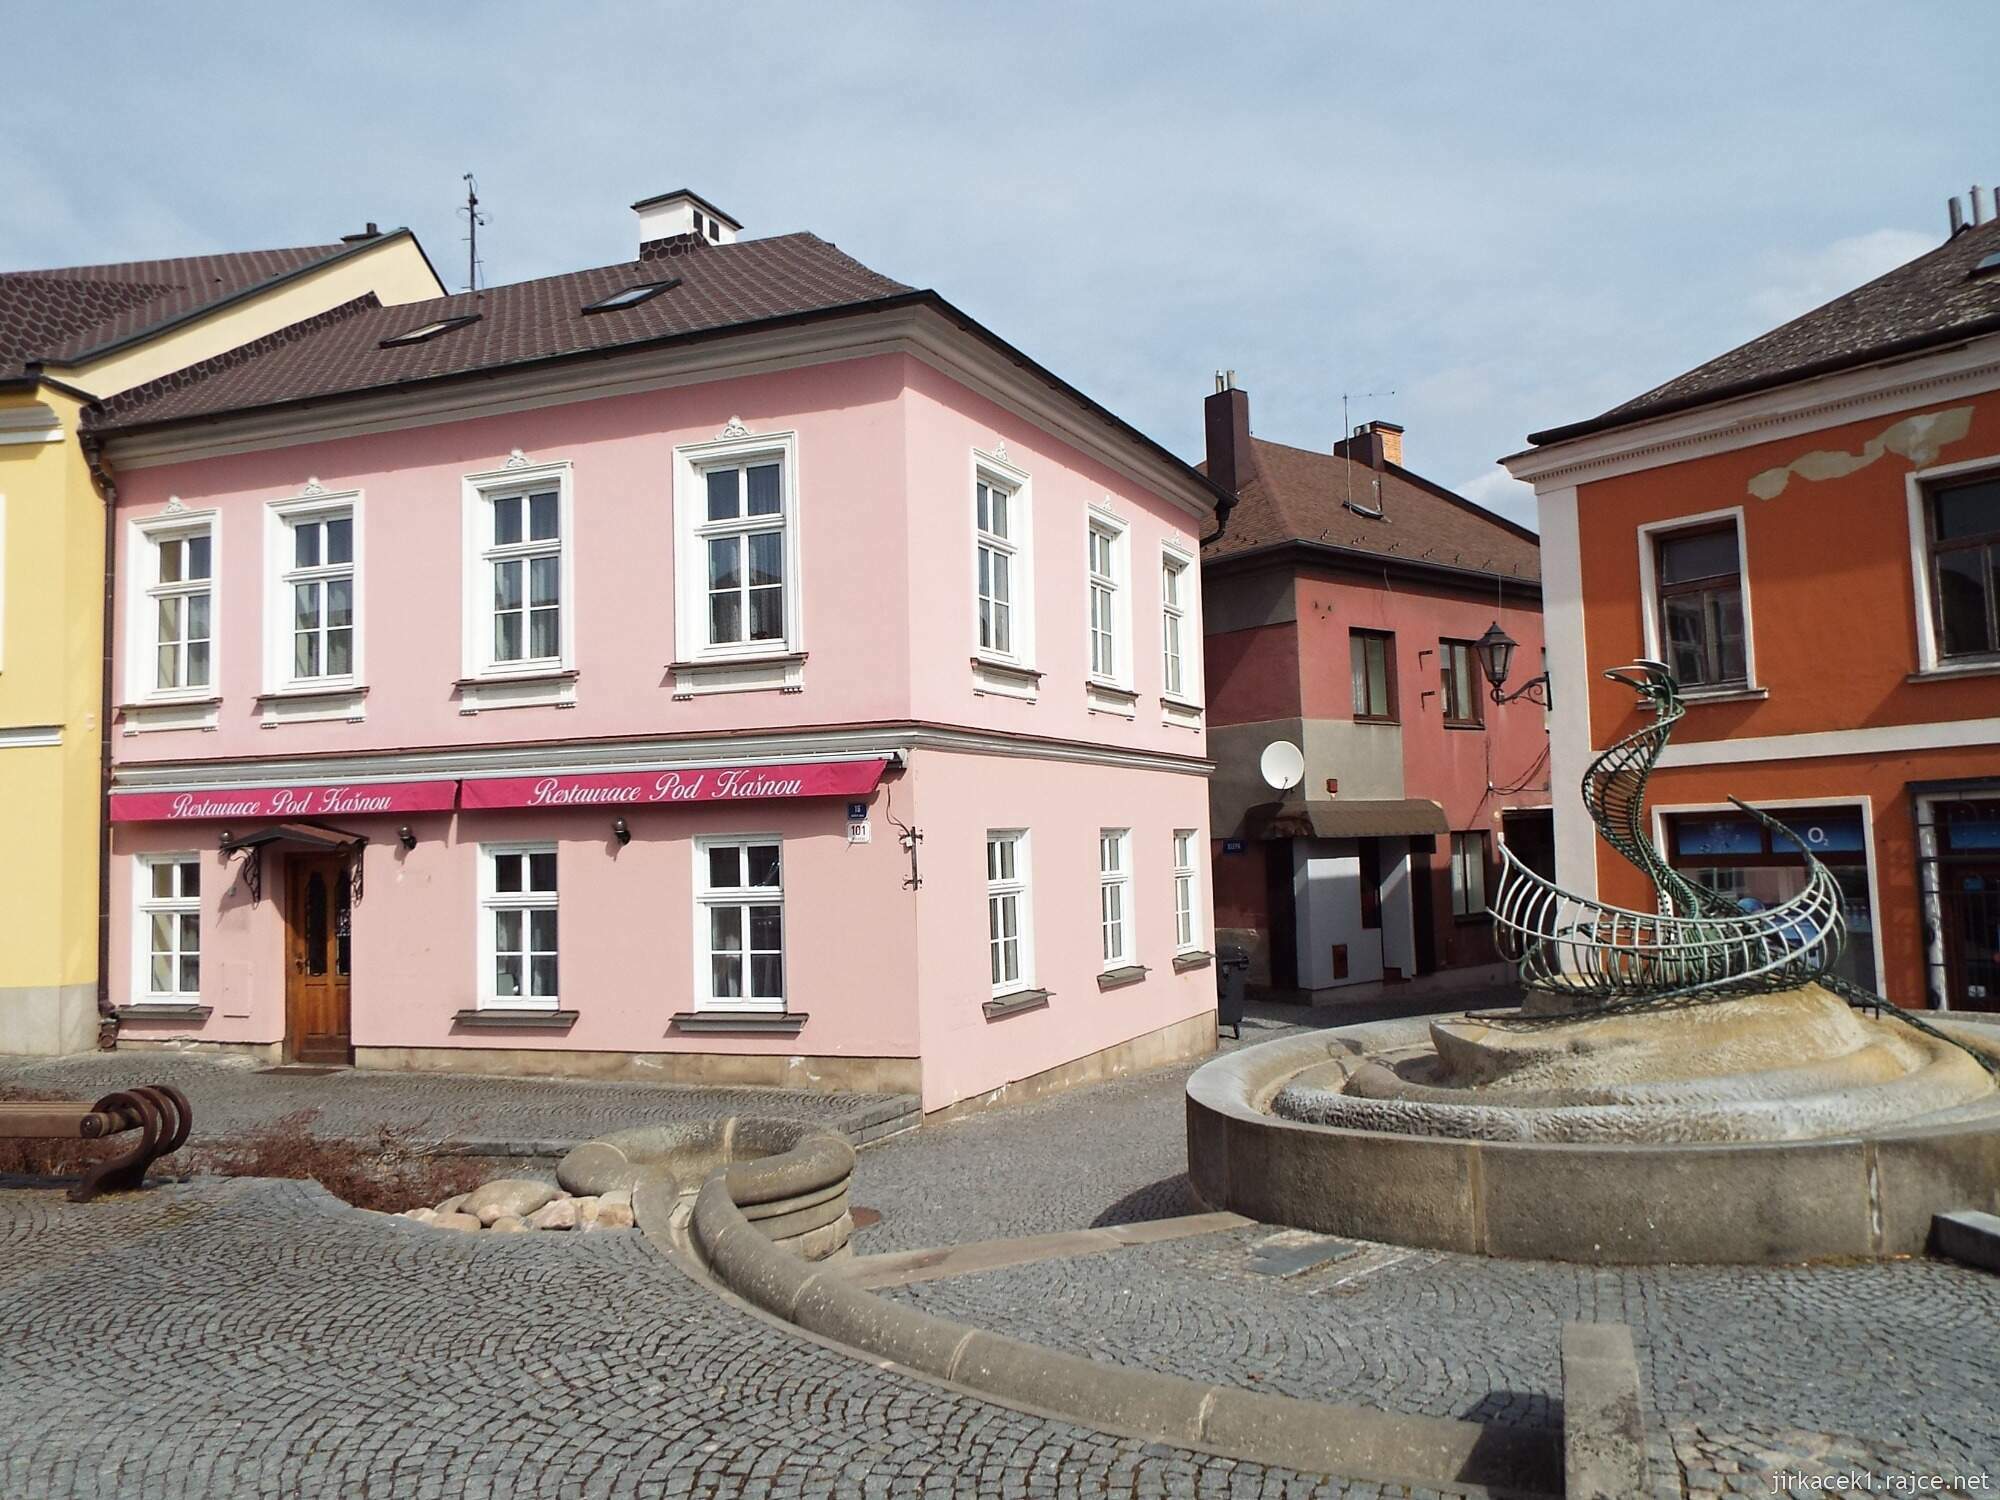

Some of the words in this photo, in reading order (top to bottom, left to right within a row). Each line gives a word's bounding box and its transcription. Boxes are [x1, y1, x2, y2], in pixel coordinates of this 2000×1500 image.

[529, 777, 640, 805] Restaurace
[649, 772, 703, 799] Pod
[712, 769, 802, 797] Kašnou
[168, 794, 259, 818] Restaurace
[266, 791, 310, 814] Pod
[318, 788, 392, 811] Kašnou
[851, 825, 866, 835] 101
